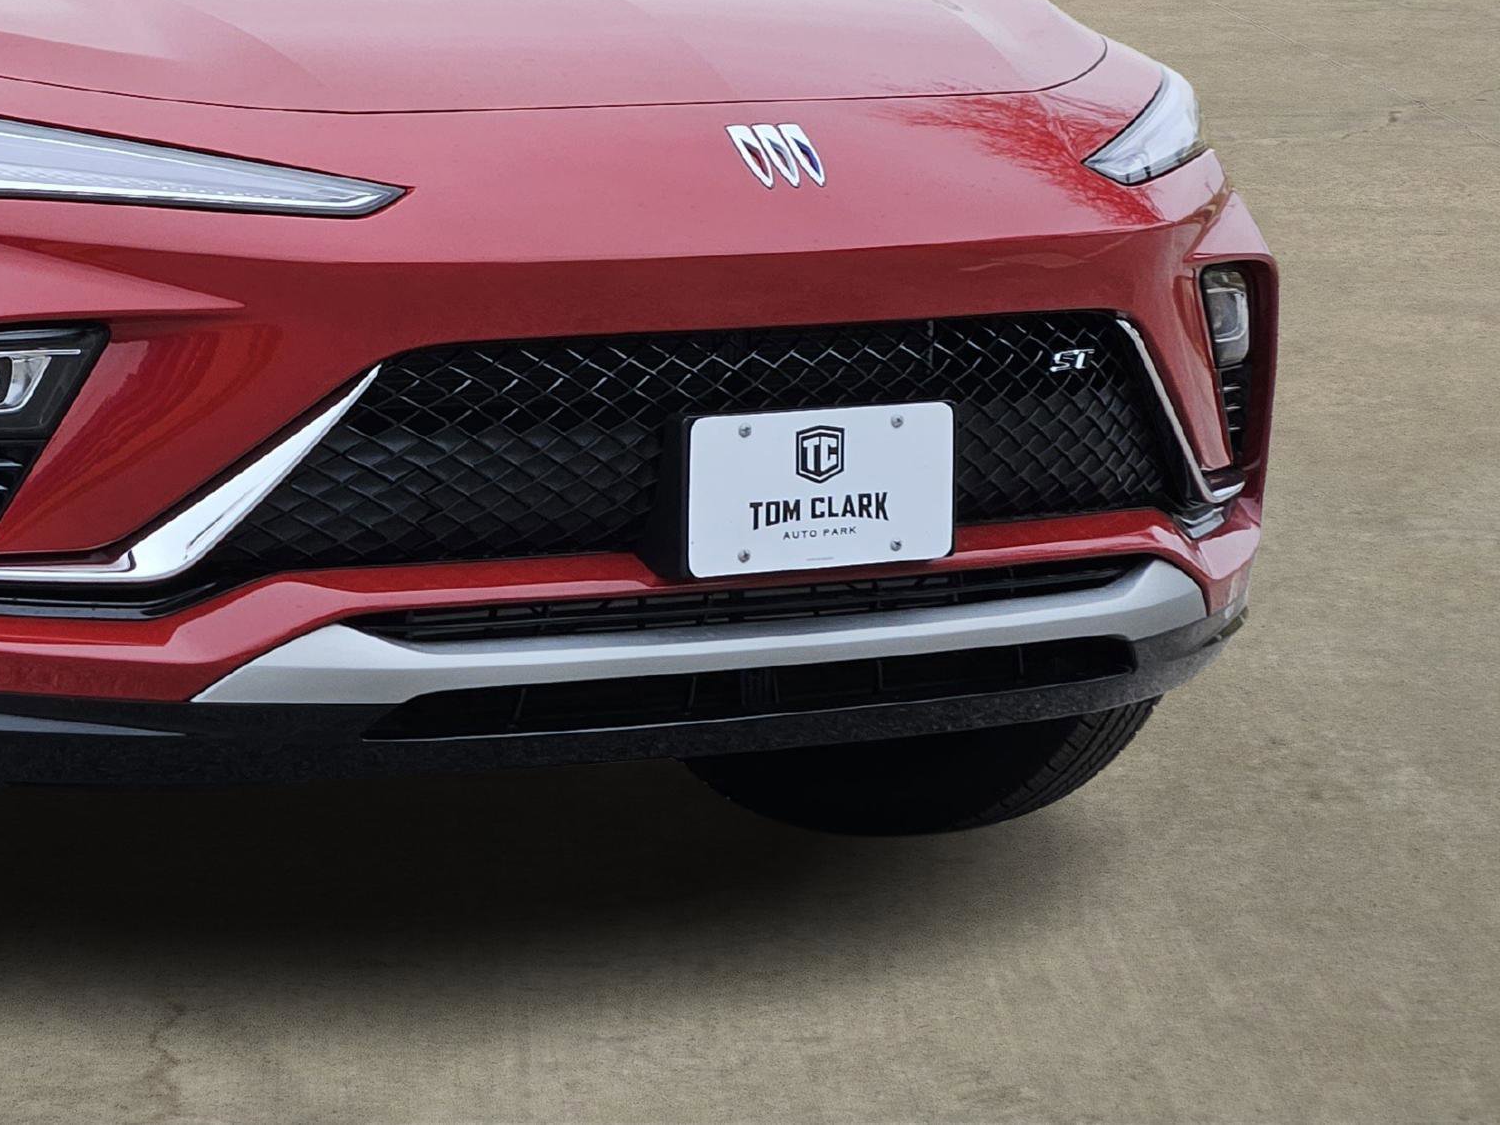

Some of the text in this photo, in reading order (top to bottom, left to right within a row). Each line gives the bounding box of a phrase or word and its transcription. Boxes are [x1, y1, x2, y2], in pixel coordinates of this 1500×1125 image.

[802, 435, 839, 472] TC
[749, 491, 889, 531] TOM CLARK
[782, 526, 857, 540] AUTO PARK
